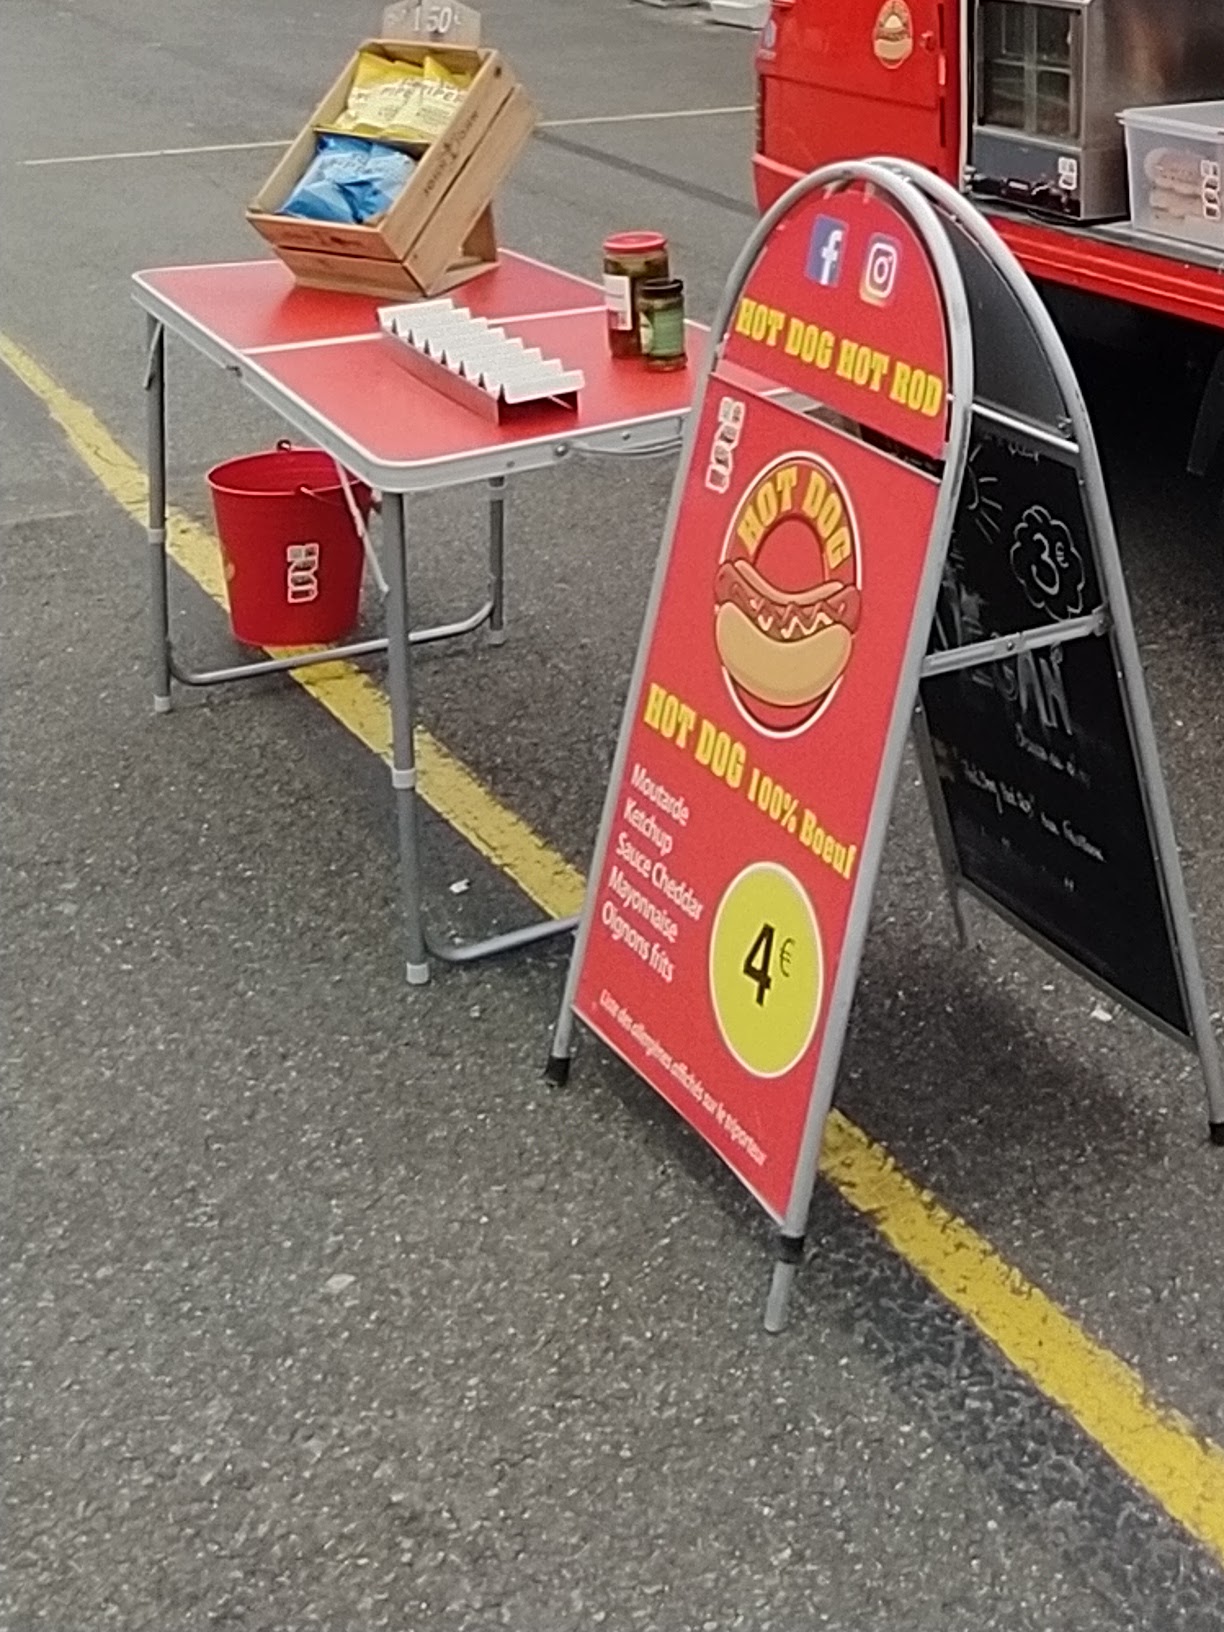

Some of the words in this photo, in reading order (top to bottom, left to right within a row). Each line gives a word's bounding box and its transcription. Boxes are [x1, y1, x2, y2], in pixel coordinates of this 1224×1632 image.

[734, 297, 786, 347] HOT
[784, 317, 836, 370] DOG
[835, 338, 891, 392] HOT
[888, 360, 944, 418] ROD
[736, 465, 798, 557] HOT
[801, 469, 852, 570] DOG
[630, 762, 690, 827] Moutarde
[643, 682, 697, 749] HOT
[694, 718, 747, 789] DOG
[747, 767, 799, 834] 100%
[798, 808, 858, 880] Boeuf
[622, 796, 673, 857] Ketchup
[607, 865, 679, 944] Mayonnaise
[615, 831, 652, 879] Sauce
[651, 861, 704, 921] Cheddar
[601, 900, 651, 961] Oignons
[648, 942, 676, 984] frits
